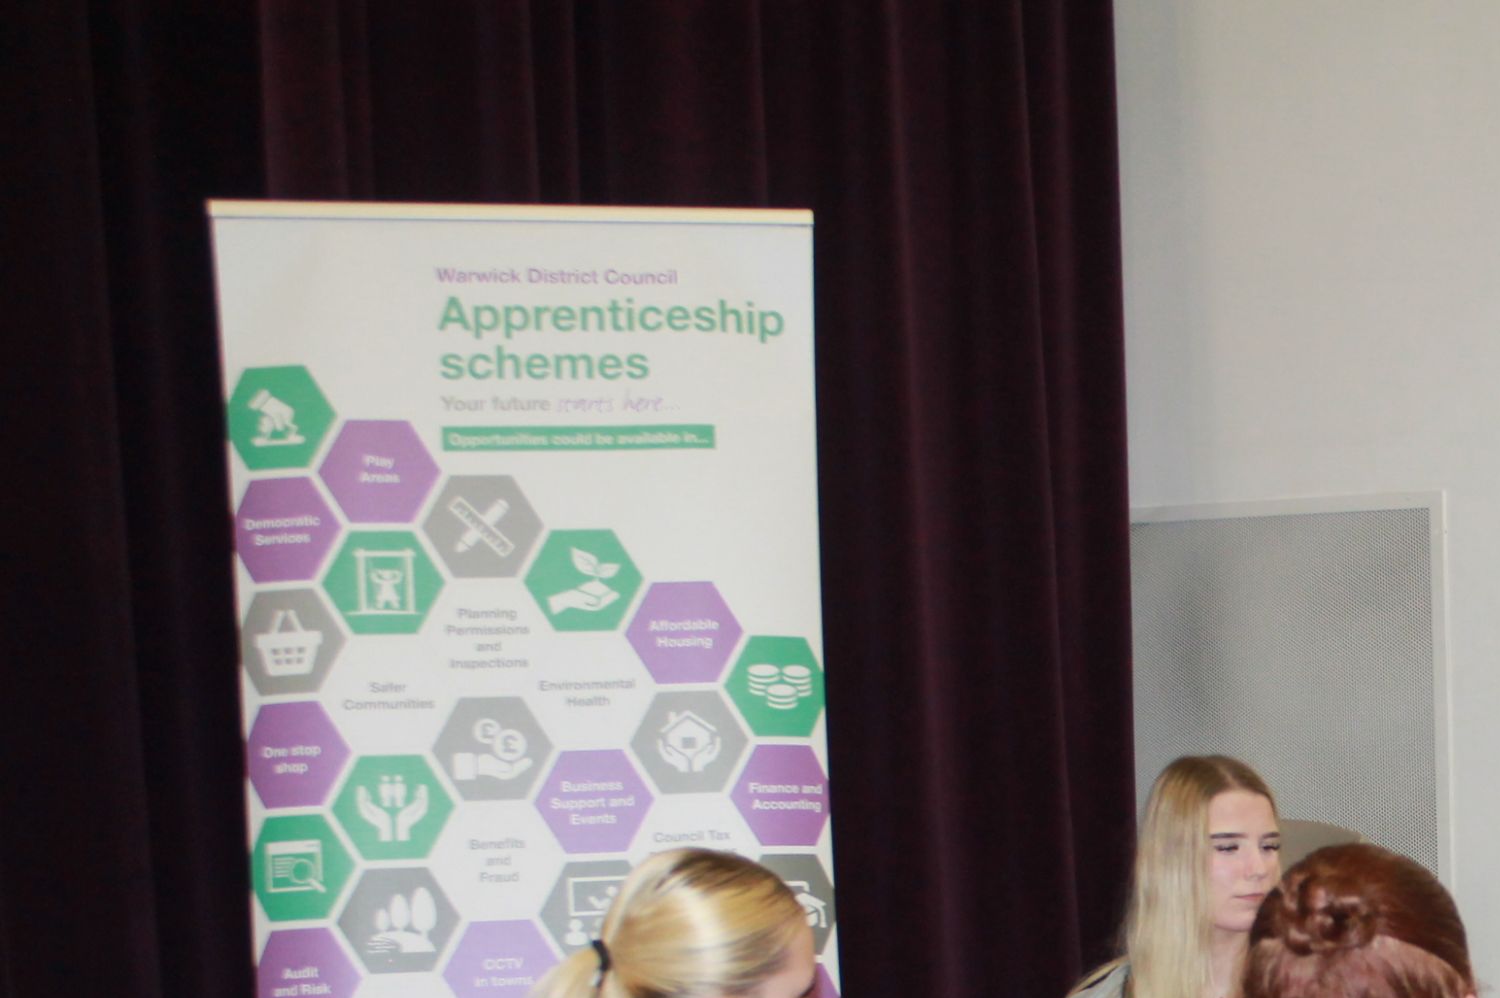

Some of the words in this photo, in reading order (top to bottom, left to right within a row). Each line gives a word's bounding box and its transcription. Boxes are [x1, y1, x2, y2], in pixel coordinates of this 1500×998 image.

[436, 267, 521, 284] Warwick
[527, 267, 598, 285] District
[603, 268, 678, 286] Council
[438, 296, 785, 344] Apprenticeship
[439, 345, 651, 381] schemes
[441, 395, 484, 412] Your
[491, 394, 550, 412] future
[450, 431, 548, 447] Opportunities
[553, 431, 592, 446] could
[599, 431, 614, 445] be
[617, 430, 680, 446] available
[363, 455, 394, 469] Play
[360, 472, 400, 483] Areas
[244, 515, 321, 530] Democratic
[254, 533, 311, 546] Services
[456, 608, 518, 621] Planning
[446, 624, 530, 636] Permissions
[649, 619, 720, 632] Affordable
[475, 641, 502, 652] and
[656, 635, 713, 649] Housing
[449, 657, 529, 669] Inspections
[369, 682, 406, 693] Safer
[538, 679, 636, 692] Environmental
[343, 698, 435, 711] Communities
[566, 696, 611, 707] Health
[262, 747, 288, 759] One
[291, 745, 321, 758] stop
[273, 762, 308, 774] shop
[561, 781, 623, 793] Business
[749, 783, 799, 795] Finance
[801, 783, 823, 795] and
[551, 798, 606, 811] Support
[609, 796, 634, 807] and
[752, 799, 821, 813] Accounting
[570, 813, 617, 825] Events
[653, 830, 704, 843] Council
[708, 830, 731, 842] Tax
[469, 839, 526, 851] Benefits
[486, 856, 512, 866] and
[479, 872, 520, 883] Fraud
[484, 957, 524, 970] CCTV
[283, 967, 319, 980] Audit
[476, 977, 489, 987] in
[273, 985, 298, 997] and
[301, 983, 331, 995] Risk
